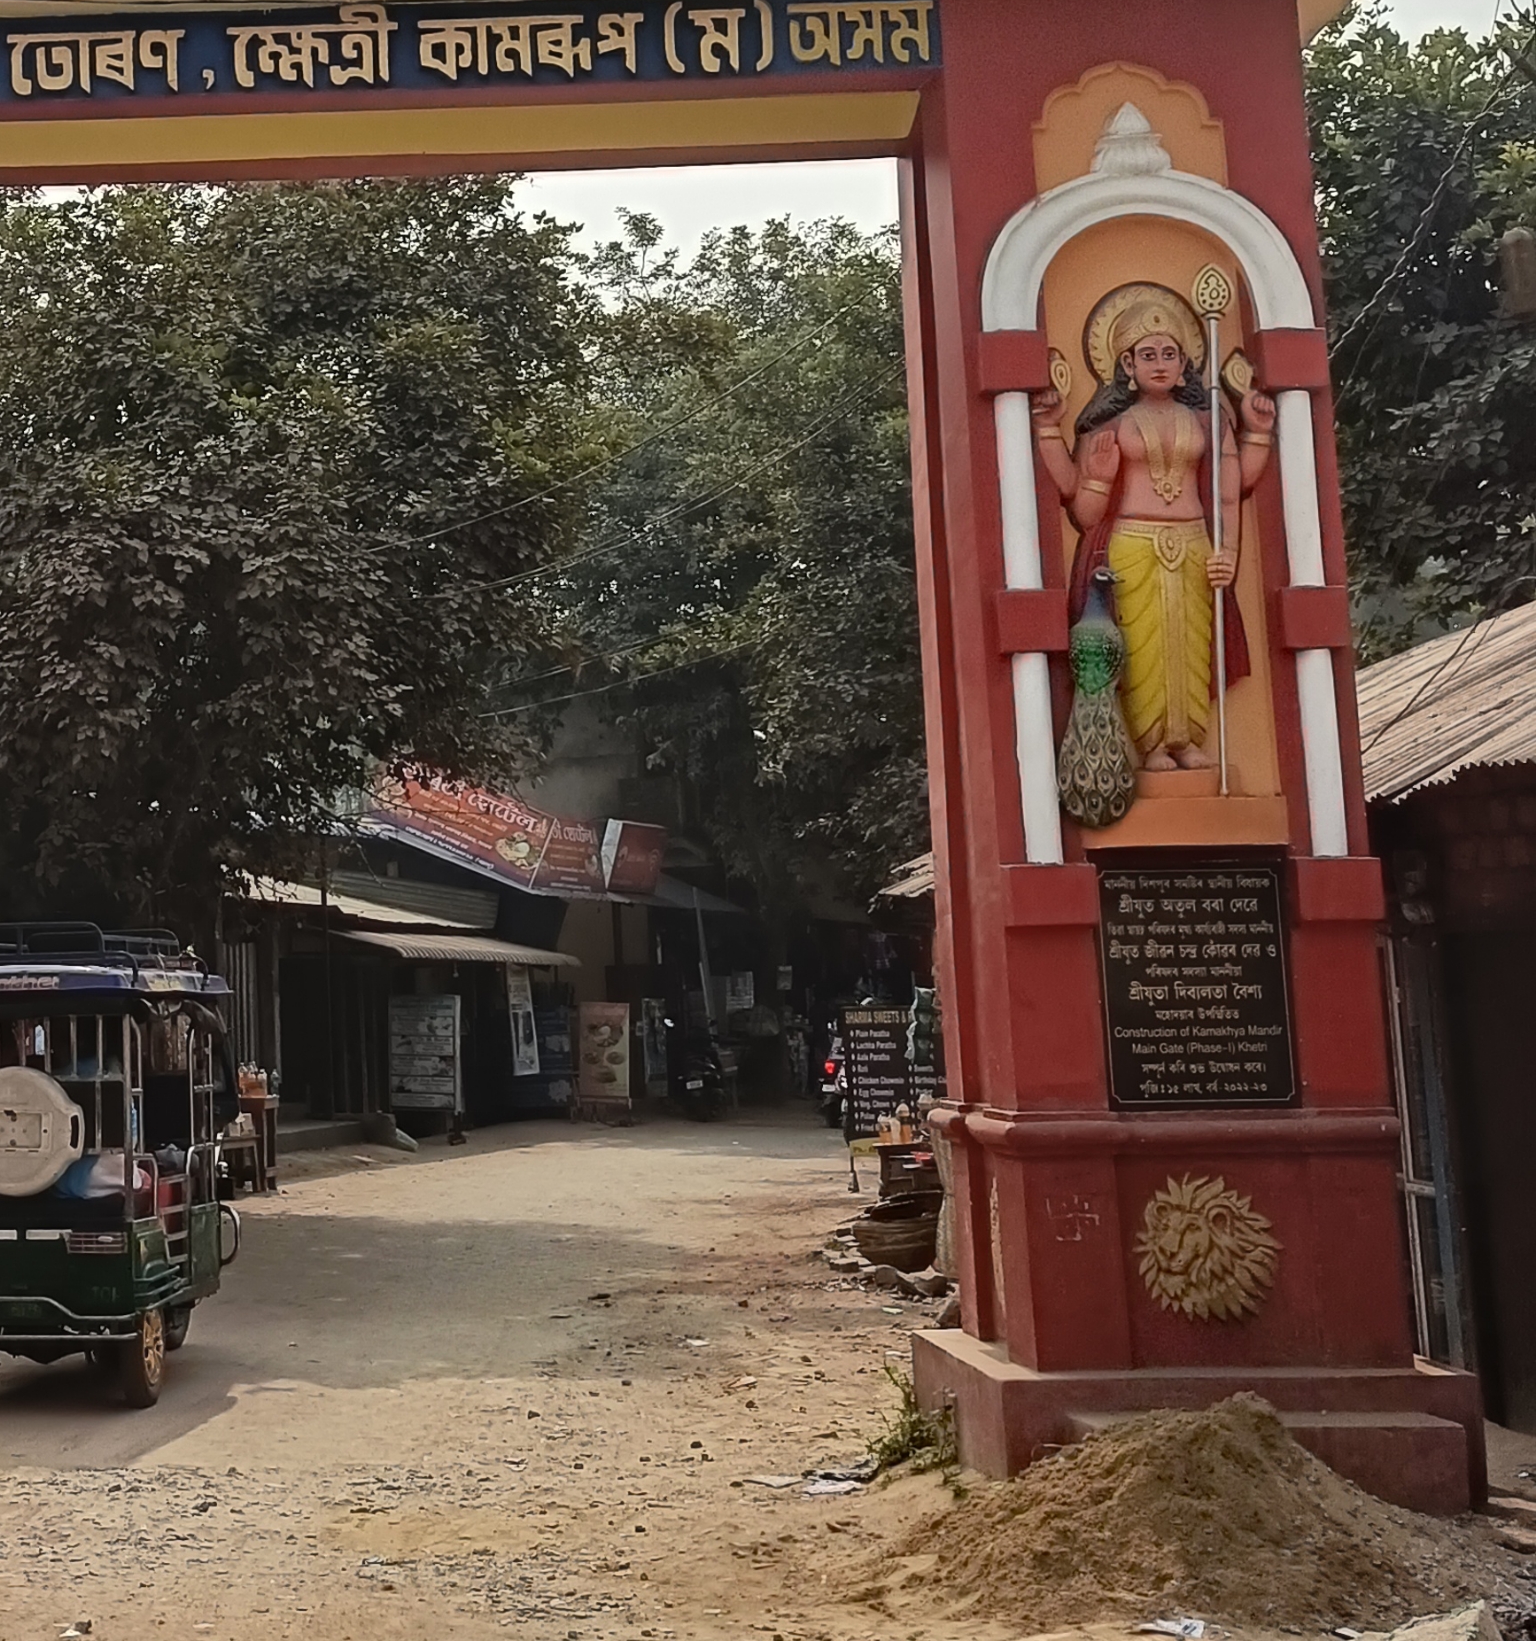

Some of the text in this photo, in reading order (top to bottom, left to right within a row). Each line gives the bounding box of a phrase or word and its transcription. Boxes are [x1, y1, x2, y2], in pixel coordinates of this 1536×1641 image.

[786, 0, 934, 66] অসম
[873, 1011, 899, 1024] SWEETS
[1114, 1025, 1282, 1039] Construction of Kamakhya Mandir
[1132, 1043, 1157, 1054] Main
[1159, 1043, 1184, 1054] Gate
[1238, 1041, 1267, 1053] Khetri
